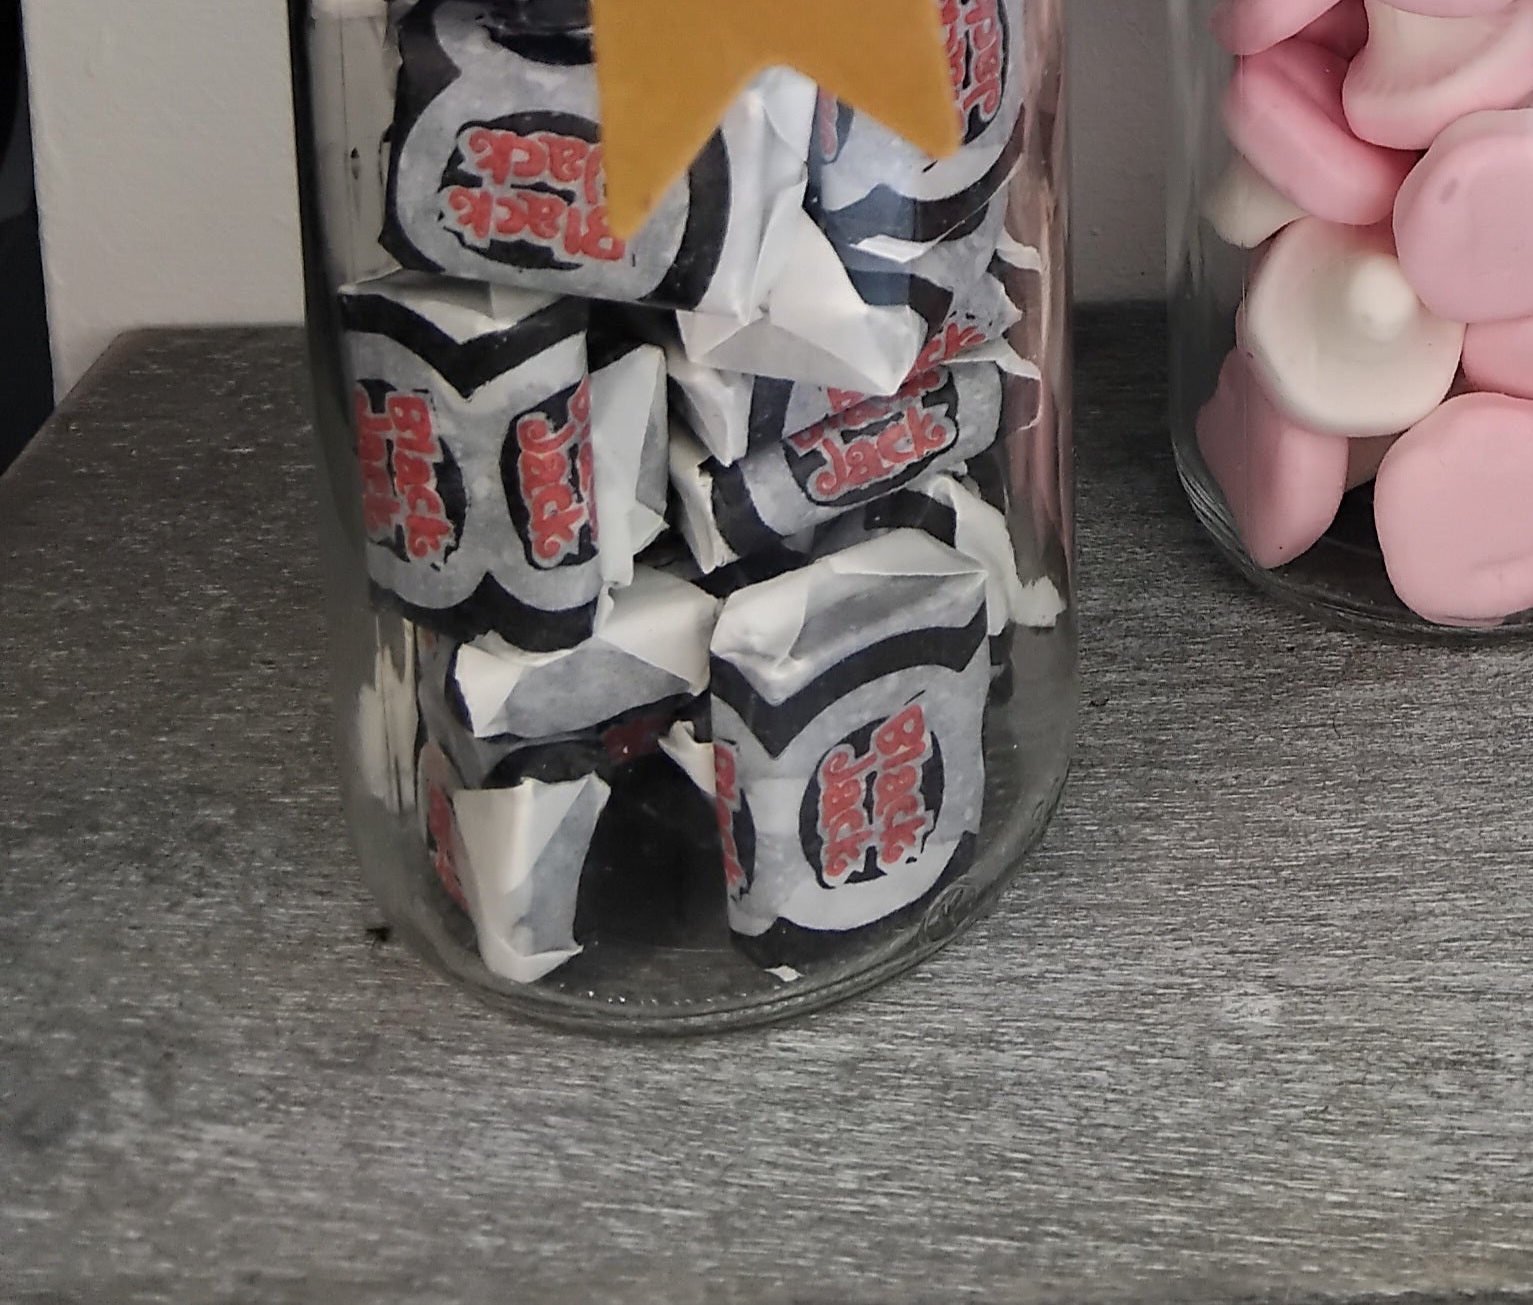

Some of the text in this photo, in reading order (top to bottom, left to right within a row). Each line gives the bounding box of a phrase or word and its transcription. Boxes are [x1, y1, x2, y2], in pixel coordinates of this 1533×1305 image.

[386, 395, 451, 558] Black
[517, 418, 585, 559] Jack
[815, 405, 947, 497] Jack
[822, 750, 878, 877] Jack
[875, 704, 927, 864] Black
